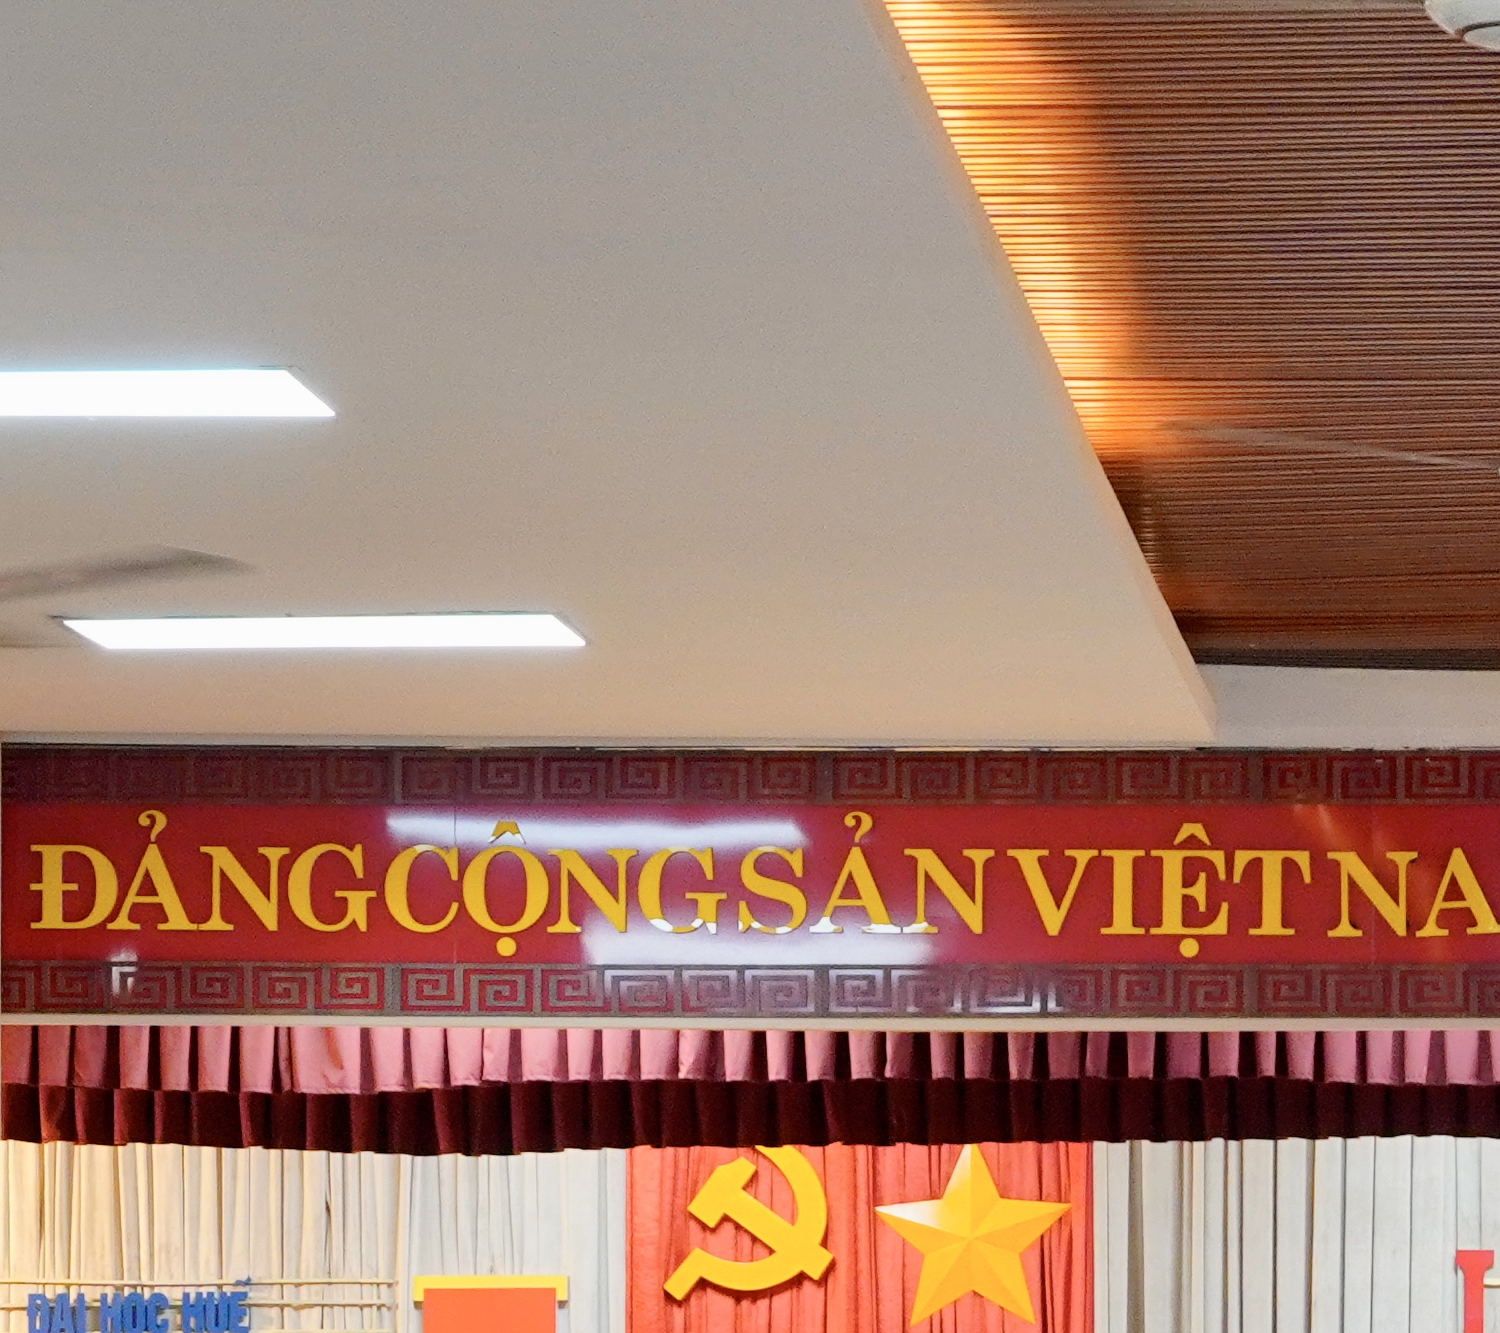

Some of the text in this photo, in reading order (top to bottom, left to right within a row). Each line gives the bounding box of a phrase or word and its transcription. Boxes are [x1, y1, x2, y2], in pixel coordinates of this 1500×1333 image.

[30, 810, 378, 936] ĐẢNG
[383, 819, 731, 959] CỘNG
[739, 810, 990, 937] SẢN
[1015, 823, 1313, 959] VIỆT
